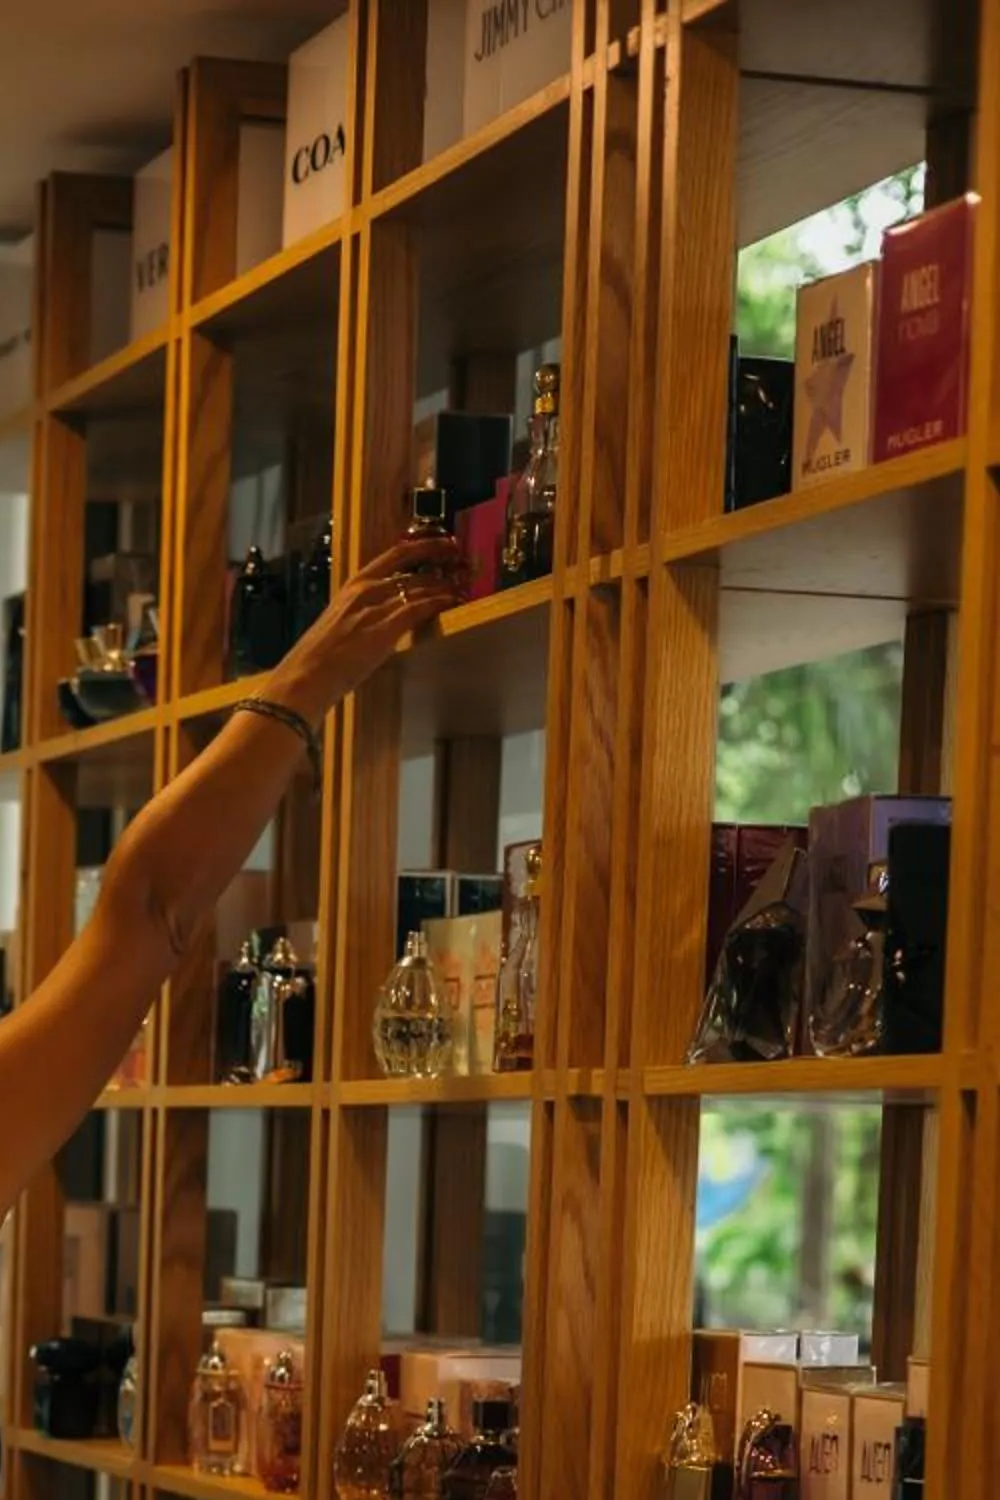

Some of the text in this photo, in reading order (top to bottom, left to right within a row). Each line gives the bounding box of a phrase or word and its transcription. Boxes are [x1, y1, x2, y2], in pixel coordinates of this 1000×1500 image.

[474, 0, 529, 62] JIMMY
[292, 122, 345, 184] COA
[901, 264, 940, 315] ANGEL
[811, 318, 846, 365] ANGEL
[887, 419, 944, 450] MUGLER
[801, 448, 851, 478] MUGLER
